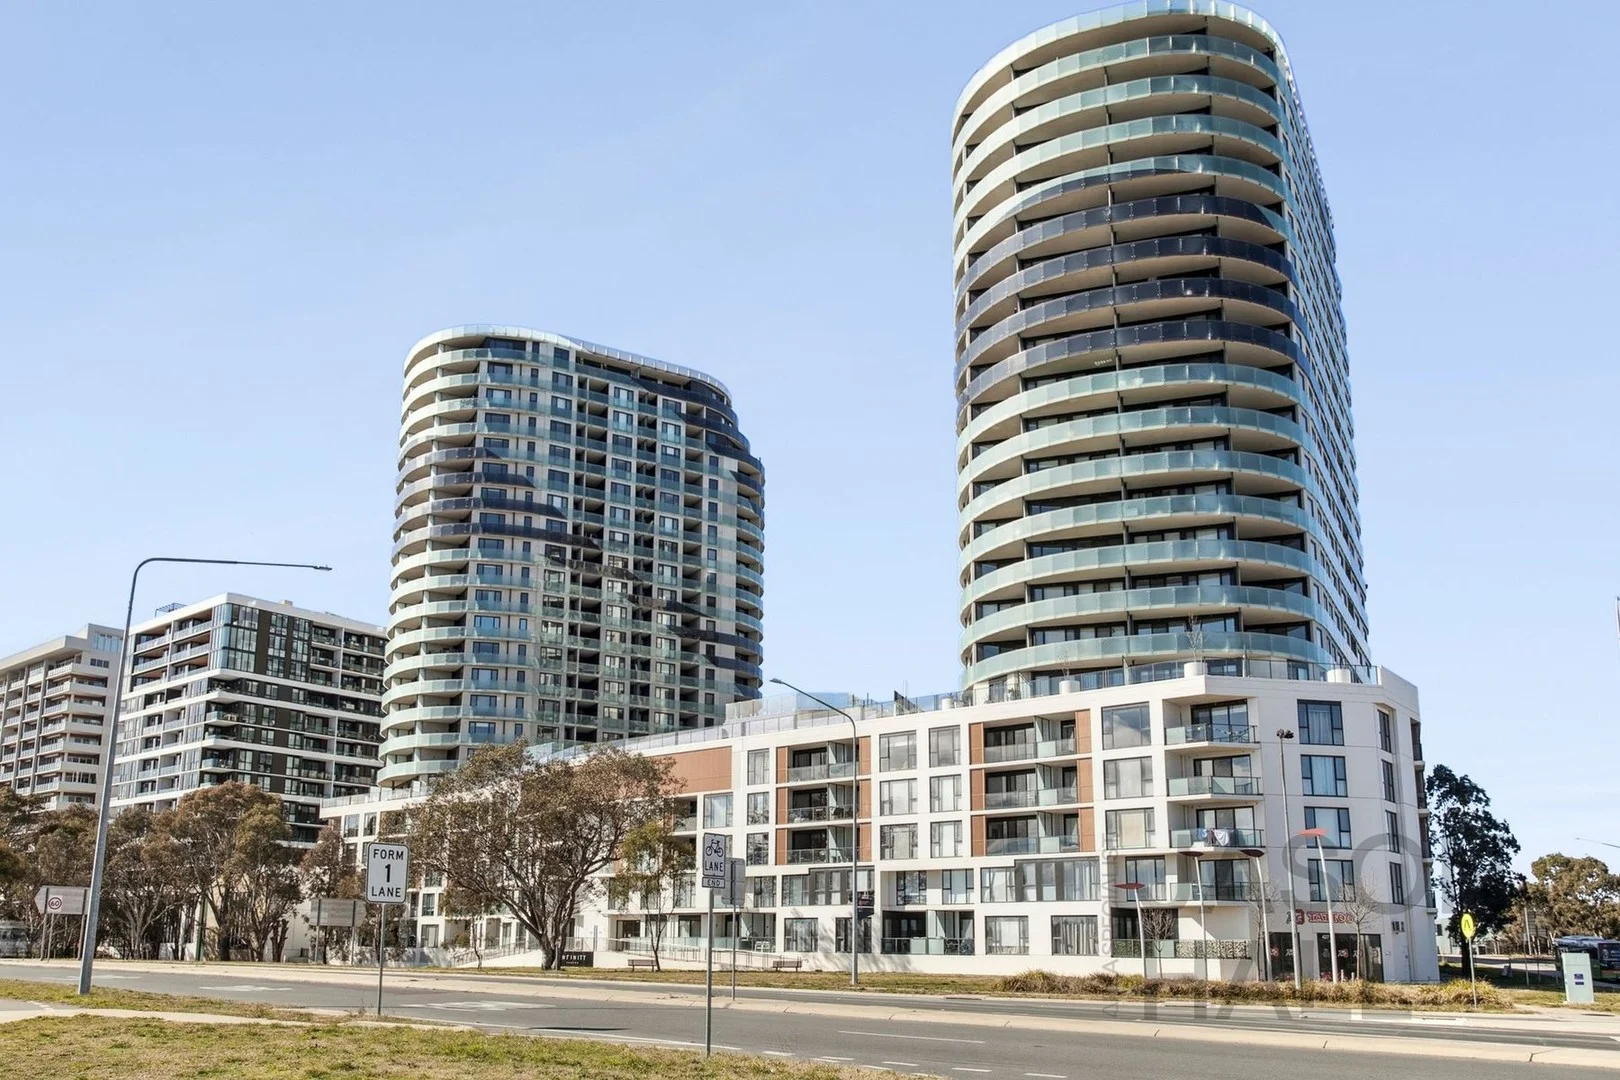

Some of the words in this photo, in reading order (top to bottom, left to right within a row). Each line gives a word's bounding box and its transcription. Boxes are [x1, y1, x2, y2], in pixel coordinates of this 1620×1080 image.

[373, 849, 404, 860] FORM
[704, 861, 724, 872] LANE
[385, 863, 391, 883] 1
[371, 886, 402, 898] LANE
